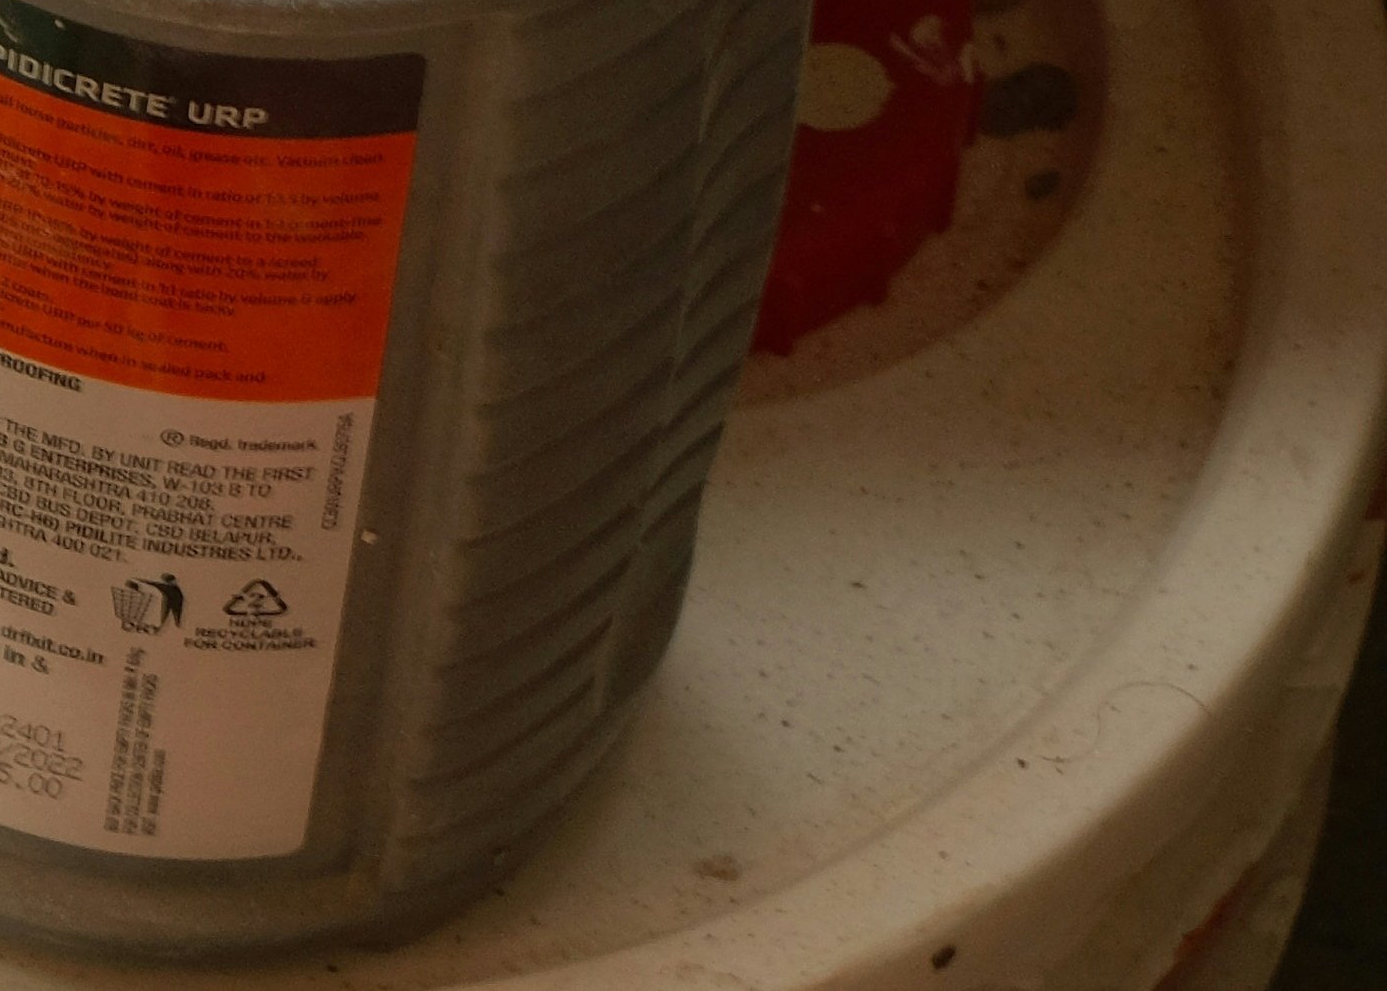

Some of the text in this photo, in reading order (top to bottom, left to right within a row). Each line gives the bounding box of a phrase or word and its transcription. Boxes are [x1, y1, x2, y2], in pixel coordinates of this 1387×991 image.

[187, 99, 269, 130] URP
[5, 417, 39, 442] THE
[41, 428, 85, 455] MFD.
[90, 444, 116, 463] BY
[119, 451, 164, 472] UNIT
[166, 458, 216, 480] READ
[221, 465, 258, 482] THE
[261, 465, 316, 482] FIRST
[29, 447, 158, 492] ENTERPRISES,
[162, 474, 225, 497] W-103
[247, 482, 274, 499] TO
[23, 474, 59, 497] 8TH
[130, 502, 214, 528] PRABHAT
[220, 512, 294, 531] CENTRE
[136, 489, 171, 508] 410
[35, 496, 73, 520] BUS
[145, 521, 184, 540] CBD
[52, 535, 85, 554] 400
[64, 520, 138, 550] PIDILITE
[142, 538, 252, 561] INDUSTRIES
[61, 589, 77, 606] &
[2, 644, 27, 668] in
[30, 653, 50, 676] &
